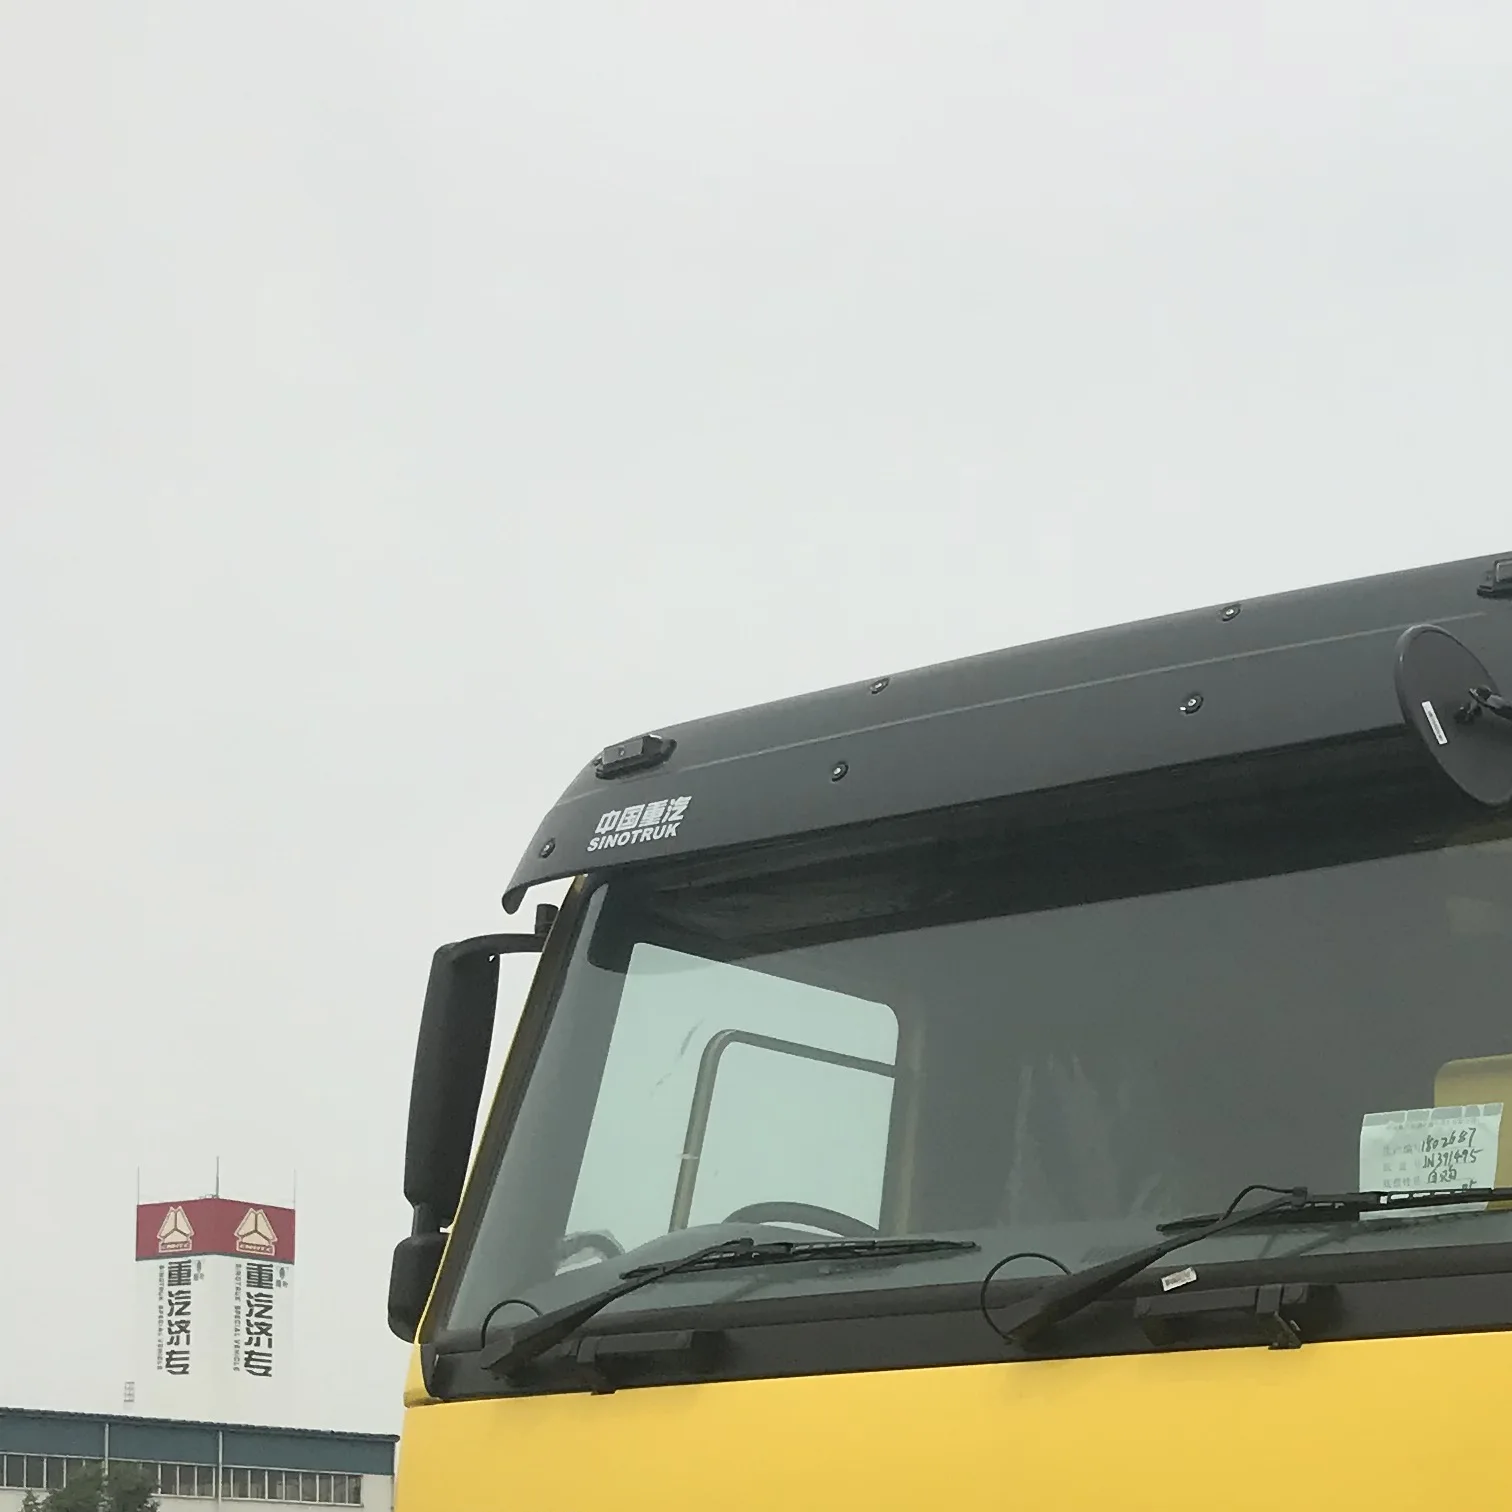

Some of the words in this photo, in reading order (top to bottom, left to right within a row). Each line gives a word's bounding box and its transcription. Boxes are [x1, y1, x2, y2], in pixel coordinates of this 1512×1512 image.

[595, 796, 692, 834] 中国重汽
[587, 822, 681, 852] SINOTRUK
